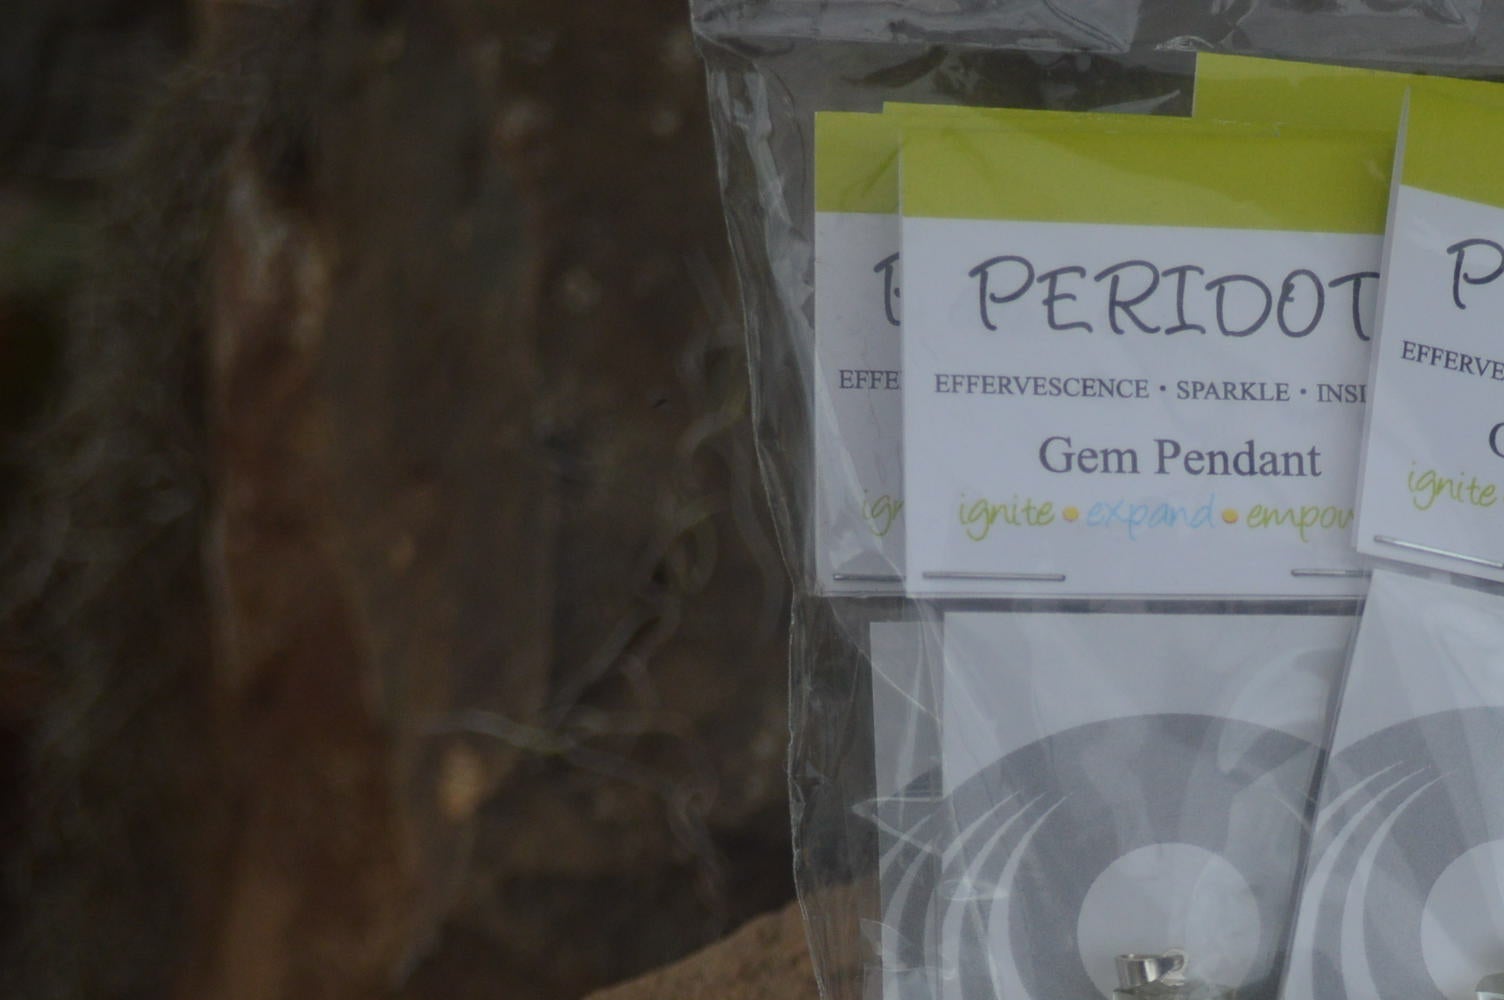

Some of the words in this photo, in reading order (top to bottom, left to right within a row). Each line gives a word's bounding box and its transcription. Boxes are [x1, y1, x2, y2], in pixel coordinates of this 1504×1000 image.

[968, 255, 1380, 341] PERIDOT
[934, 373, 1150, 399] EFFERVESCENCE
[1176, 381, 1290, 402] SPARKLE
[1038, 436, 1140, 475] Gem
[1154, 439, 1322, 477] Pendant
[1407, 462, 1498, 510] ignite
[958, 493, 1056, 541] ignite
[1086, 493, 1217, 540] expand
